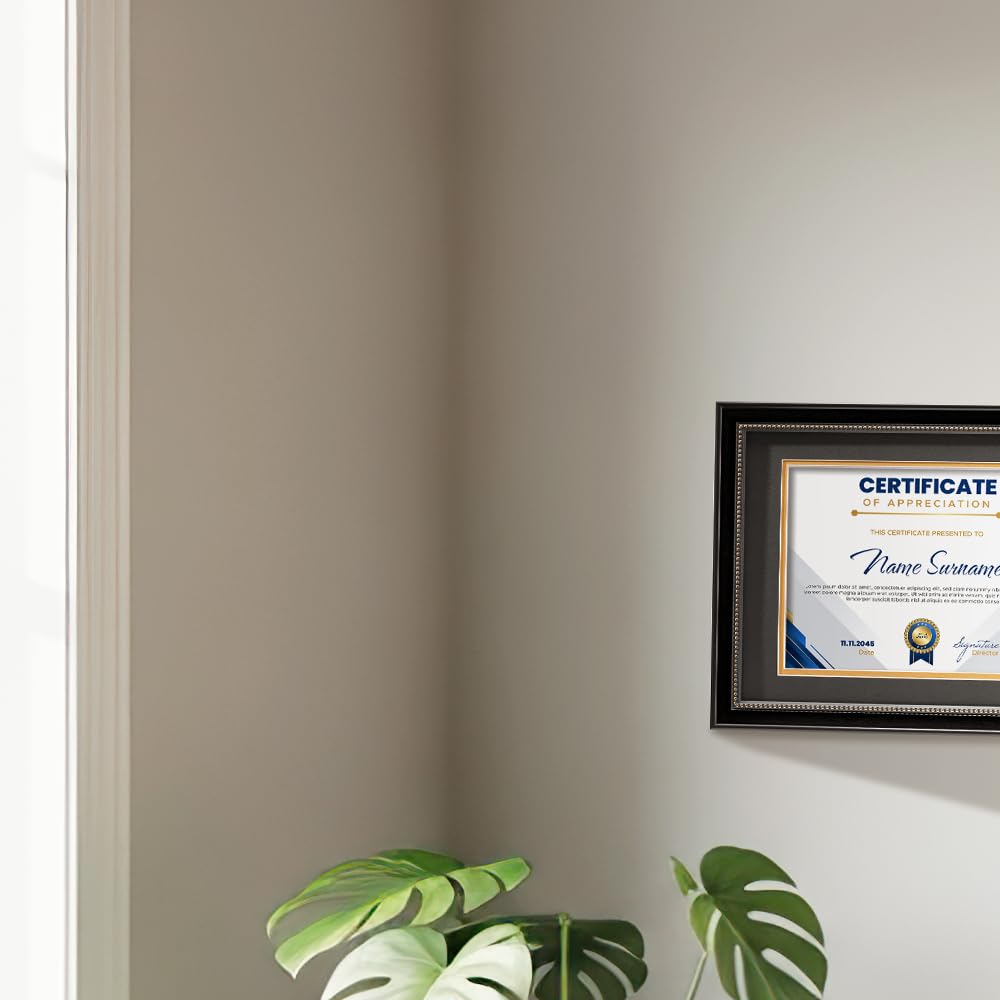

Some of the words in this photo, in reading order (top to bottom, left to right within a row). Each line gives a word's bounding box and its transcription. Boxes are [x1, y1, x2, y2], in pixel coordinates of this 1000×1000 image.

[859, 477, 997, 495] CERTIFICATE
[863, 498, 880, 507] OF
[887, 498, 991, 509] APPRECIATION
[887, 529, 930, 537] CERTIFICATE
[849, 547, 922, 576] Name
[952, 636, 1000, 663] Signature
